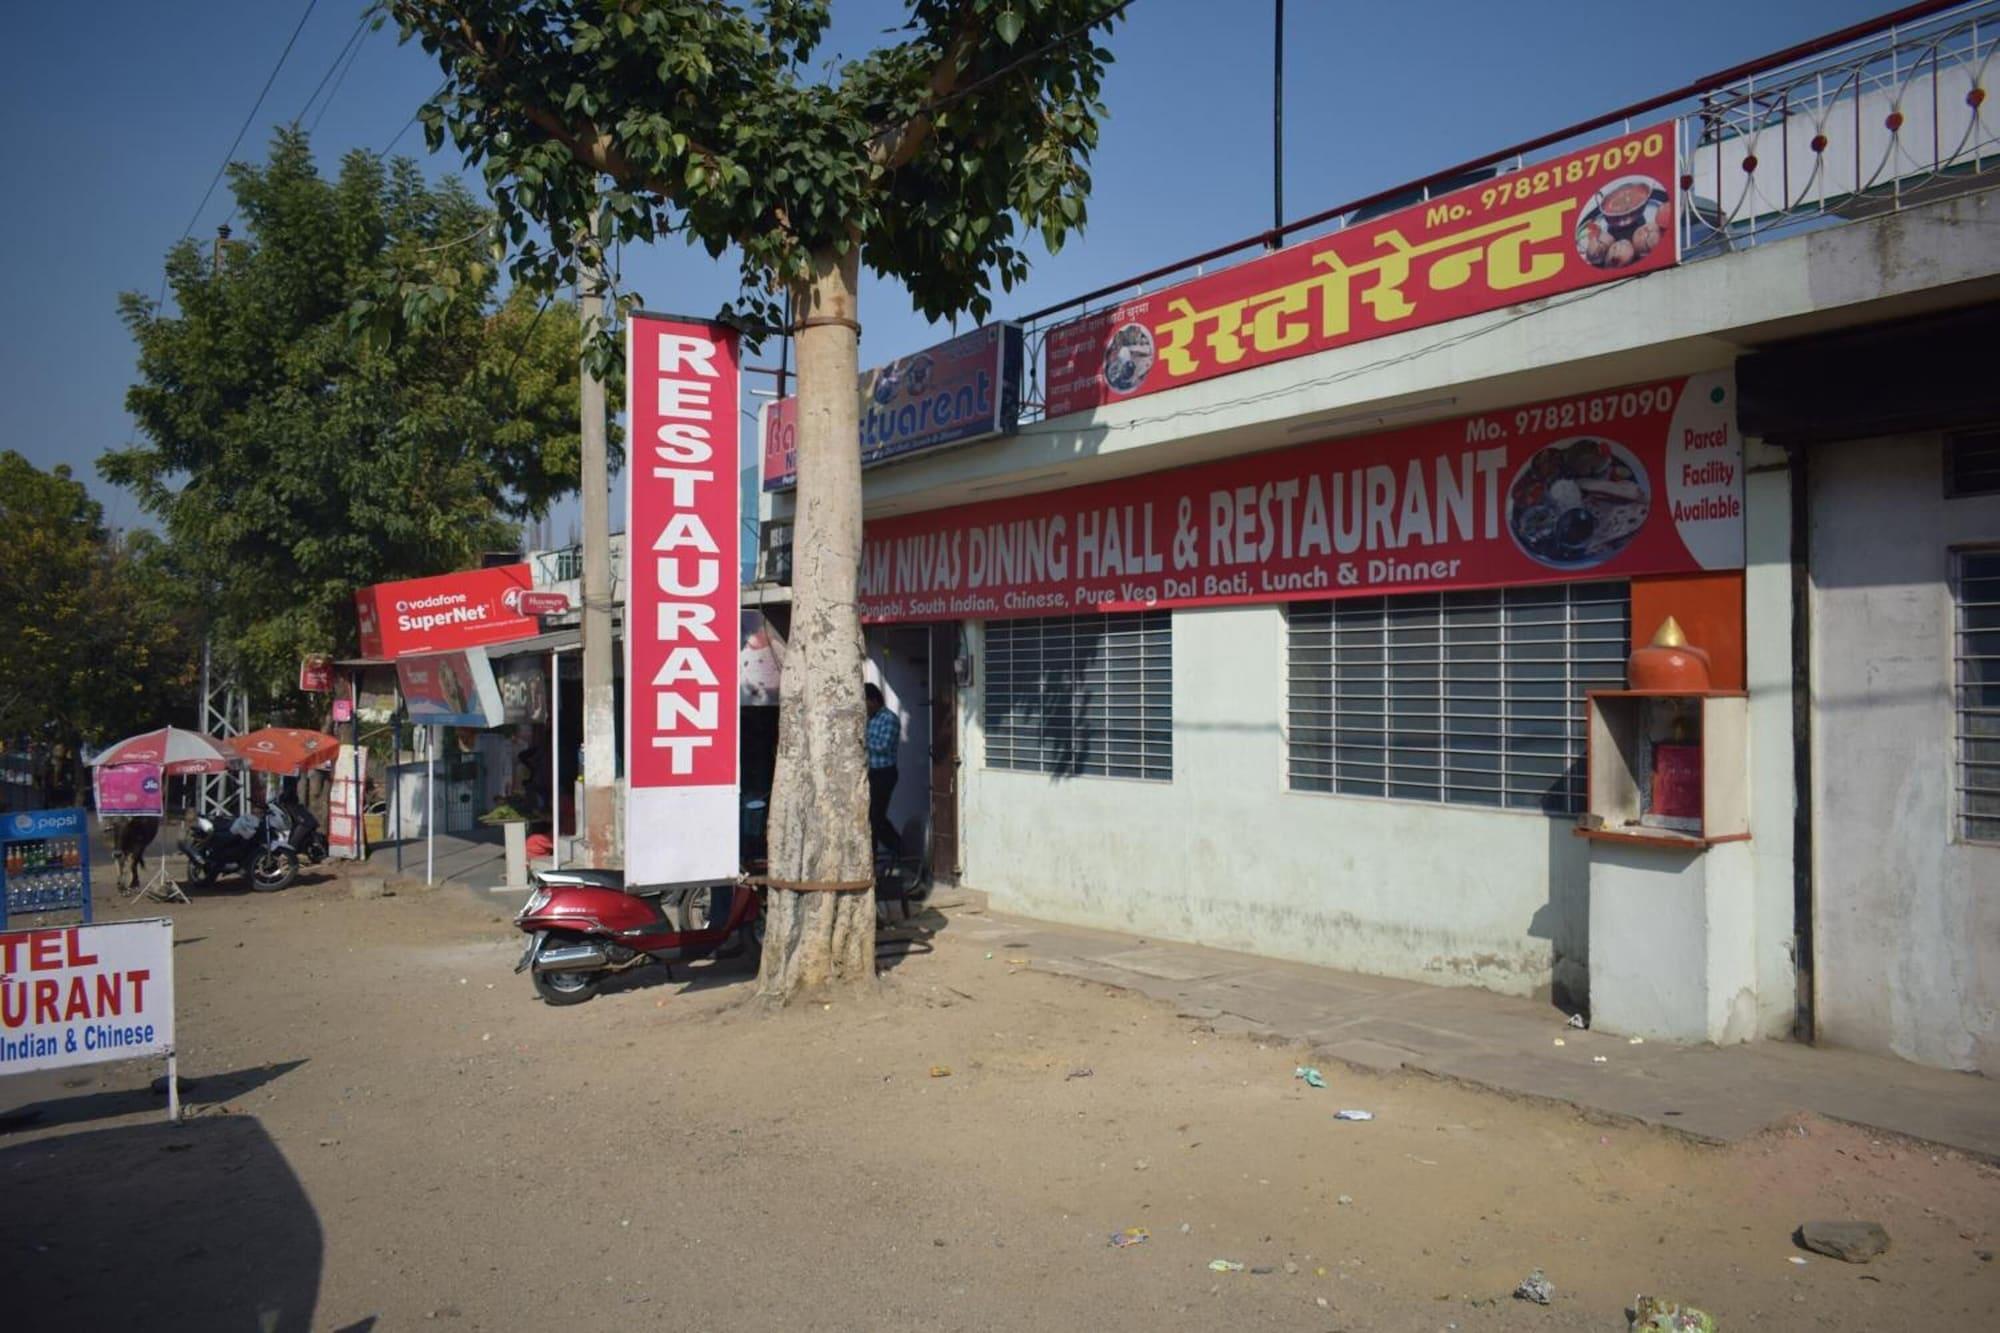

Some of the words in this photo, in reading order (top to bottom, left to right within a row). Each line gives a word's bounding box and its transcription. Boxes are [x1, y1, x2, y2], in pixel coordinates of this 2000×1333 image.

[1426, 204, 1472, 228] Mo.
[1481, 133, 1663, 210] 9782187090
[1155, 198, 1577, 376] रेस्टोरेन्ट
[1466, 420, 1508, 443] Mo.
[1515, 386, 1673, 434] 9782187090
[1684, 424, 1727, 451] Parcel
[1683, 460, 1734, 487] Facility
[895, 530, 962, 594] NIVAS
[968, 514, 1068, 588] DINING
[1076, 502, 1164, 580] HALL
[1173, 496, 1199, 571] &
[1209, 446, 1508, 567] RESTAURANT
[1674, 495, 1740, 522] Available
[652, 333, 720, 775] RESTAURANT
[409, 593, 467, 610] vodafone
[909, 597, 946, 616] South
[951, 593, 999, 613] Indian,
[1004, 590, 1069, 610] Chinese,
[1075, 586, 1114, 605] Pure
[1121, 583, 1157, 607] Veg
[1164, 576, 1197, 598] Dal
[1204, 571, 1254, 596] Bati,
[1262, 565, 1328, 591] Lunch
[1337, 562, 1360, 585] &
[1367, 558, 1462, 584] Dinner
[397, 604, 487, 632] SuperNet
[38, 813, 78, 830] pepsi
[0, 927, 98, 974] TEL
[0, 969, 150, 1028] URANT
[0, 1033, 58, 1062] Indian
[65, 1027, 78, 1053] &
[84, 1024, 154, 1050] Chinese
